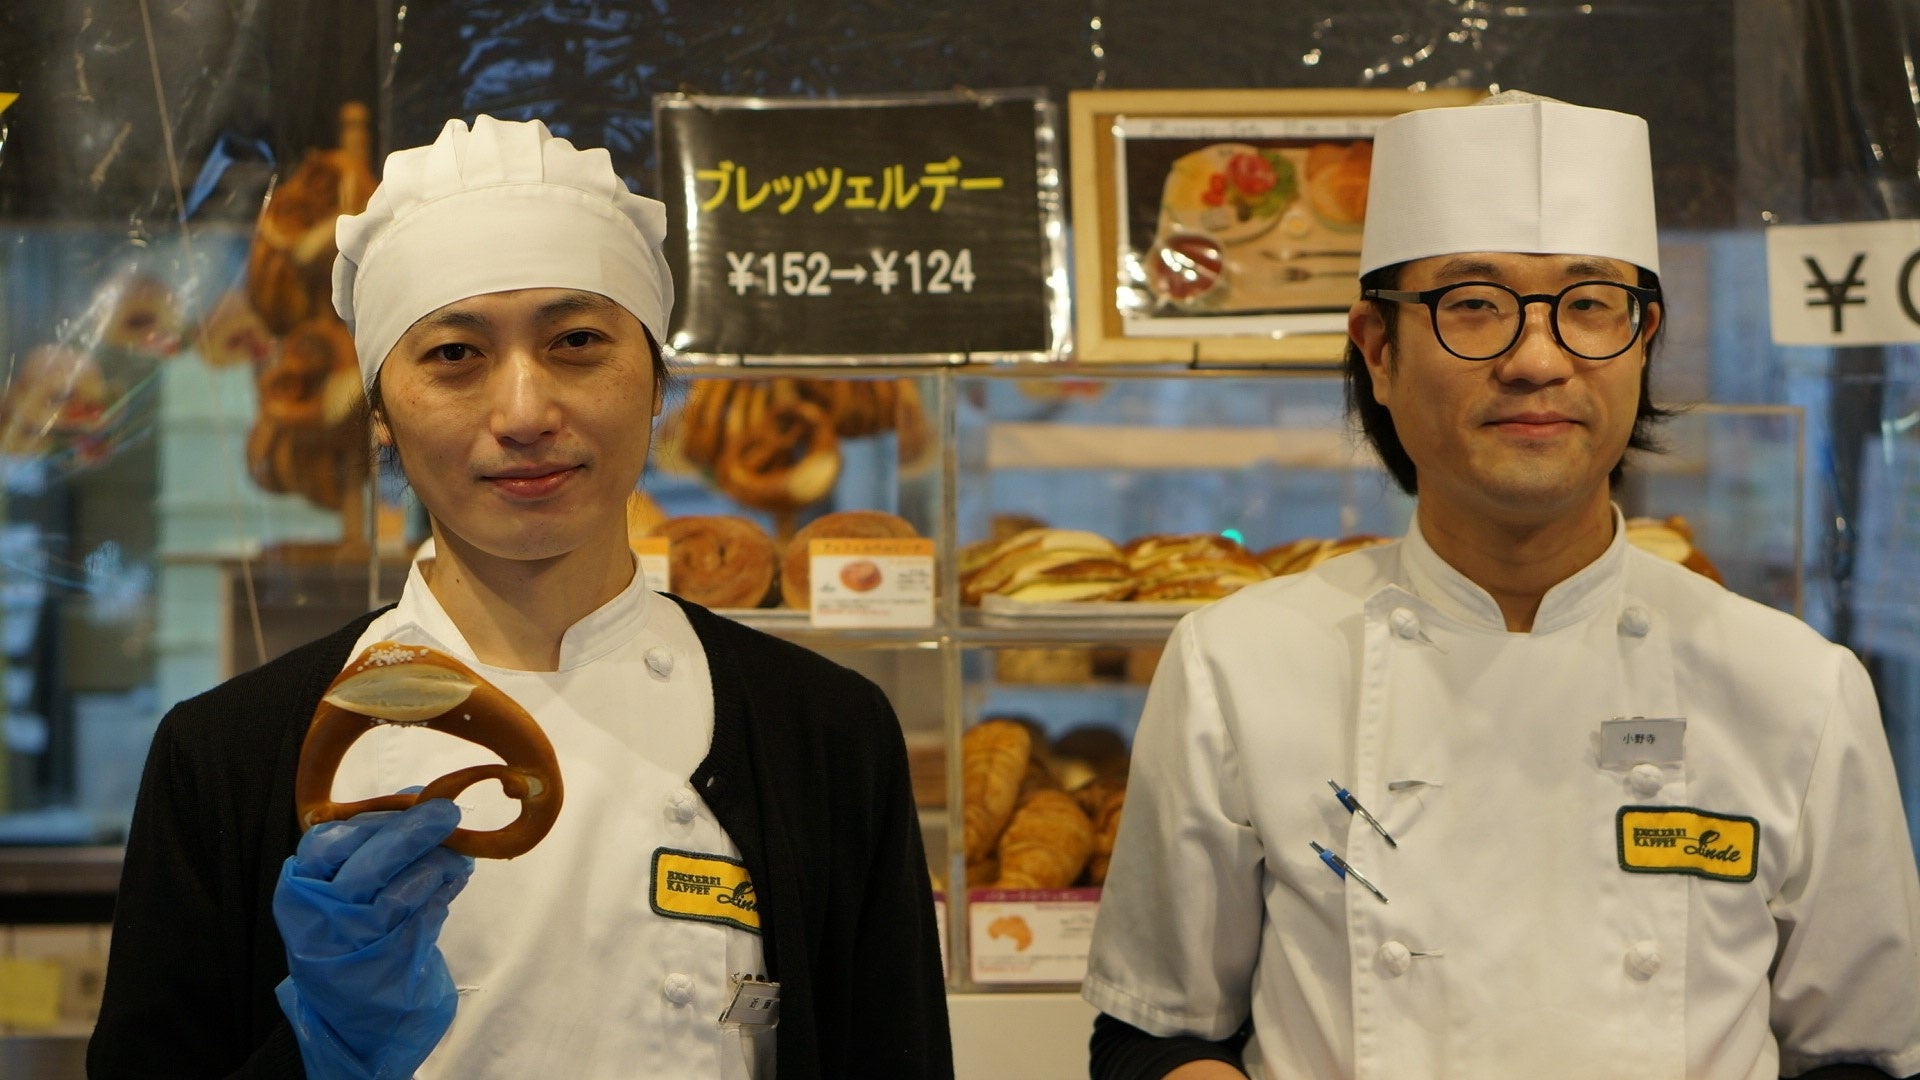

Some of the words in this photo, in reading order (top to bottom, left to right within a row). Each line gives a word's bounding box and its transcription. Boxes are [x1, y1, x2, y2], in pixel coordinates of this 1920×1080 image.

[1622, 733, 1656, 745] 小野寺
[1683, 829, 1741, 862] Linde
[667, 880, 710, 895] KAFFEE
